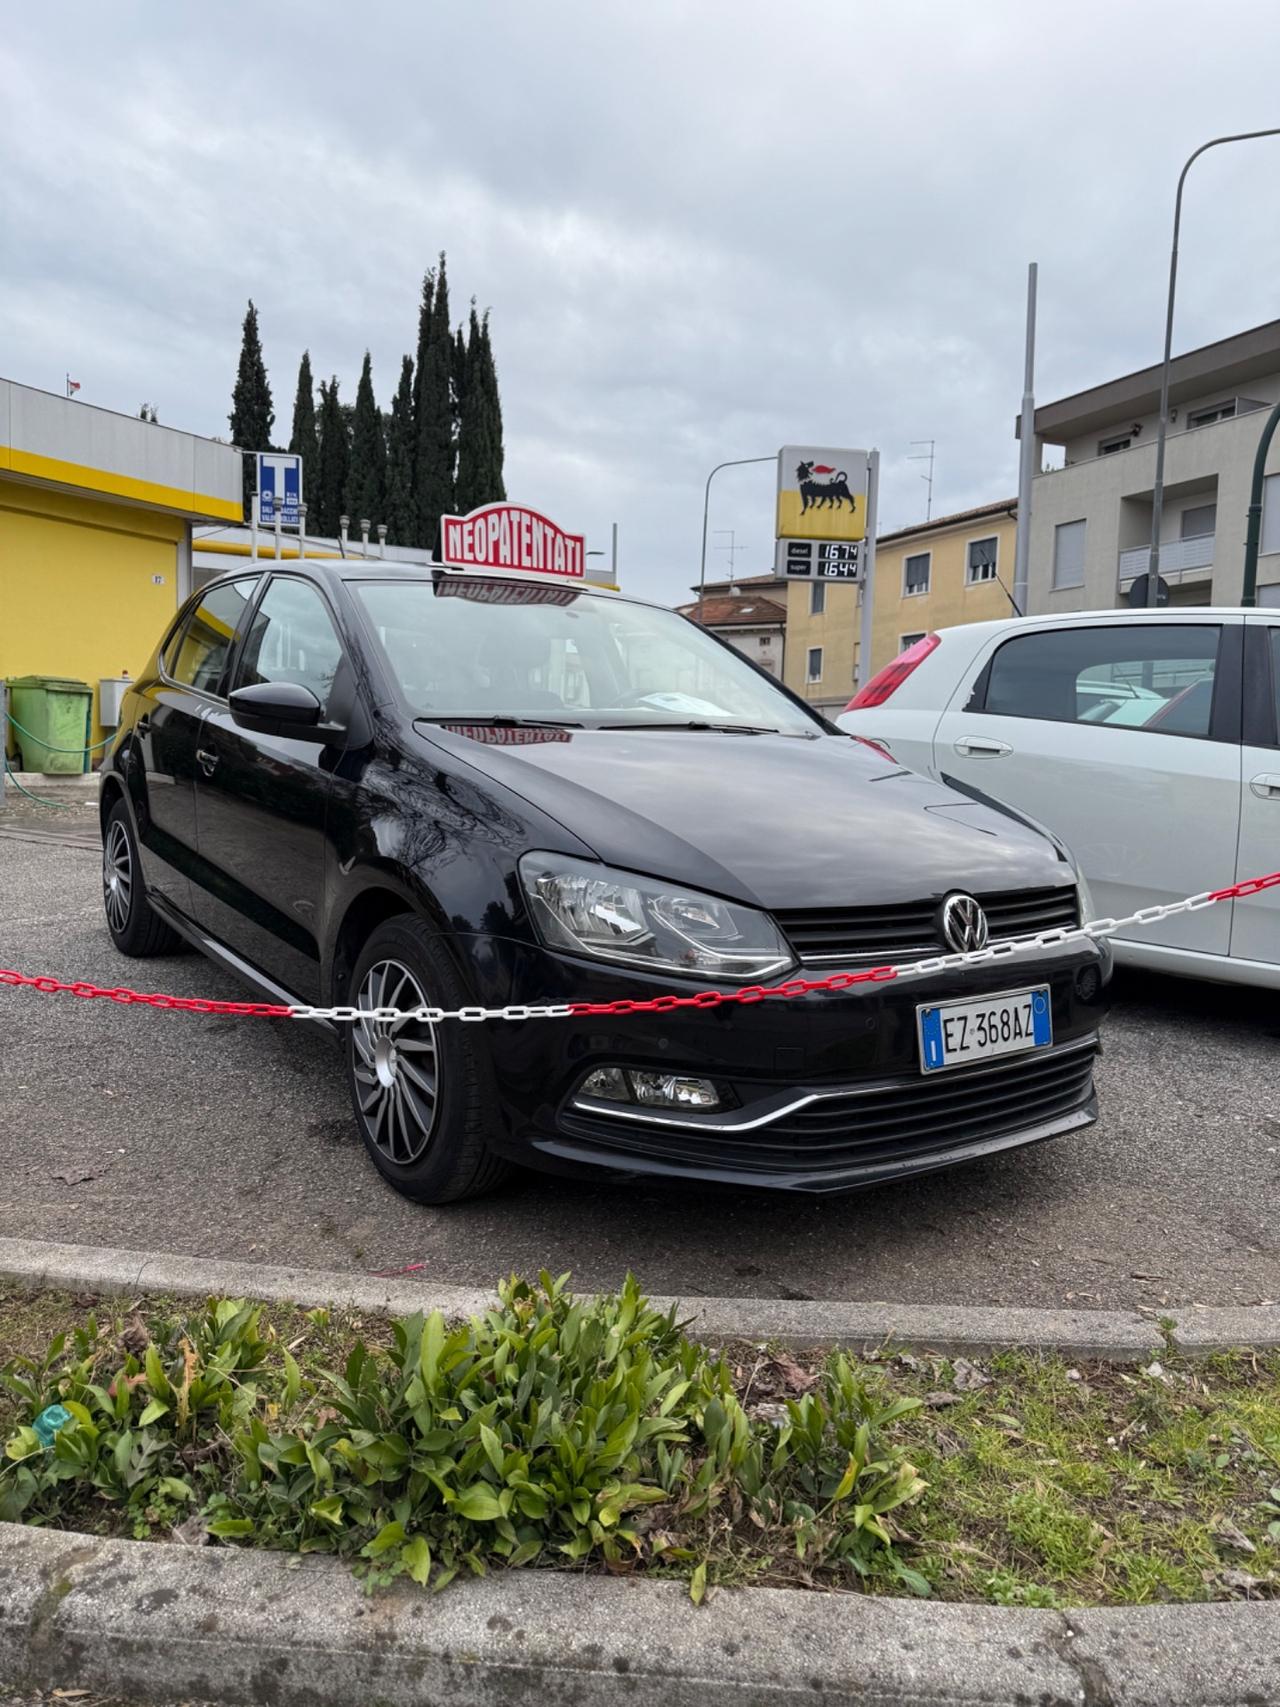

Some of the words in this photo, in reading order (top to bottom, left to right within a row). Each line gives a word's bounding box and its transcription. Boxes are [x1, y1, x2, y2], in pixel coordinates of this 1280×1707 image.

[263, 457, 296, 504] T
[449, 510, 580, 574] NEOPATENTATI
[943, 1016, 970, 1053] EZ
[976, 1004, 1034, 1048] 368AZ
